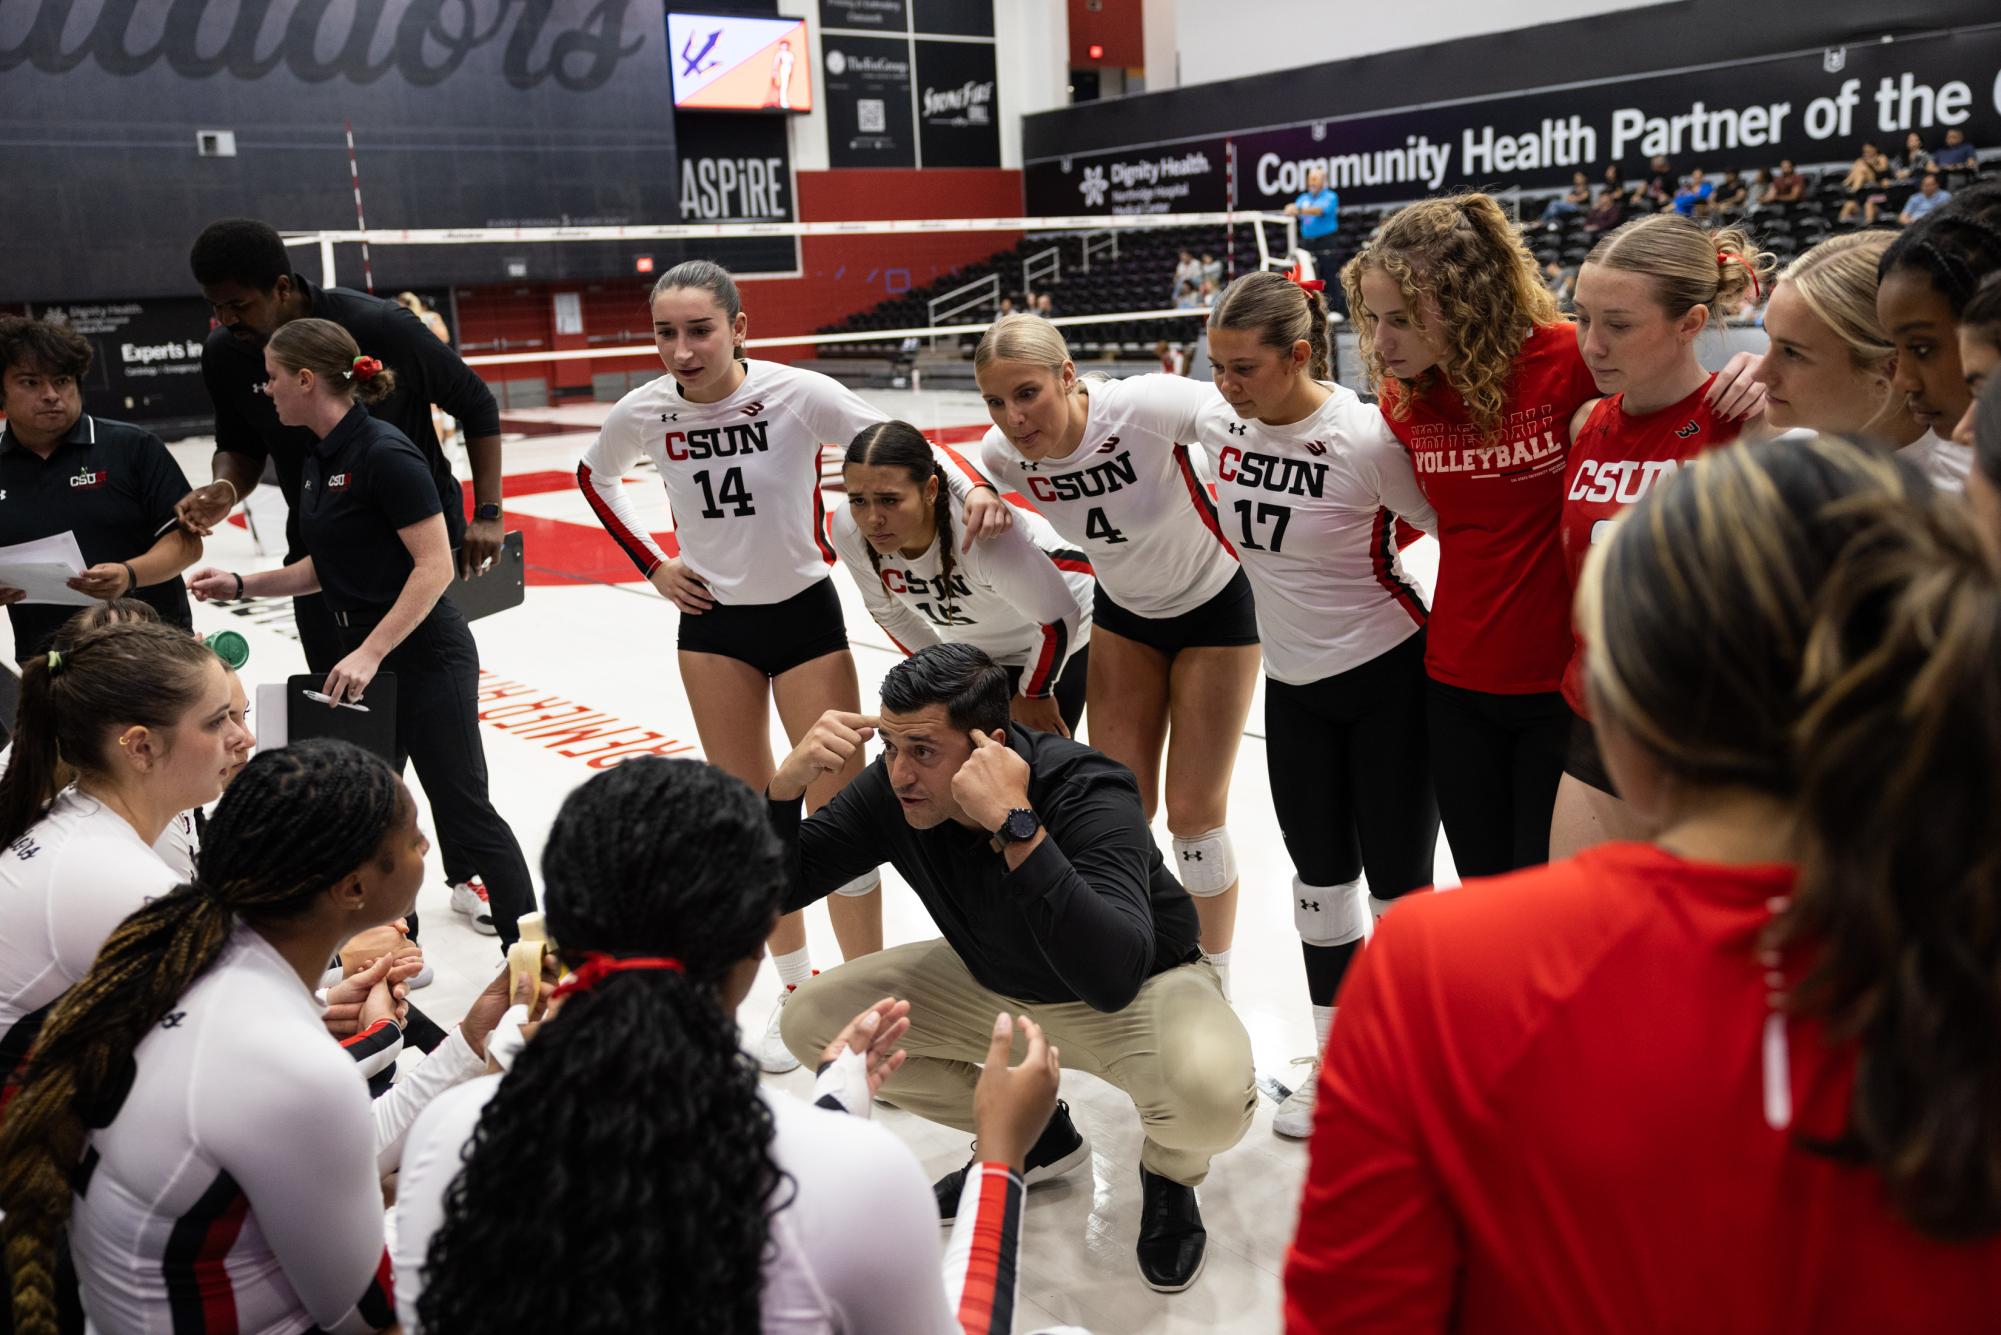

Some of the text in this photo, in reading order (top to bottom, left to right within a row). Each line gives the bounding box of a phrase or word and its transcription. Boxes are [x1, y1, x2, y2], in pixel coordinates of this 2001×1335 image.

[1462, 115, 1597, 176] Health
[1611, 102, 1792, 161] Partner
[1803, 78, 1861, 140] of
[1875, 73, 1973, 131] the
[1111, 161, 1159, 187] Dignity
[121, 342, 185, 364] Experts
[665, 420, 769, 462] CSUN
[1415, 431, 1562, 473] VOLLEYBALL
[693, 466, 756, 519] 14
[1027, 450, 1137, 502] CSUN
[1218, 445, 1330, 499] CSUN
[1085, 506, 1129, 544] 4
[1233, 499, 1292, 553] 17
